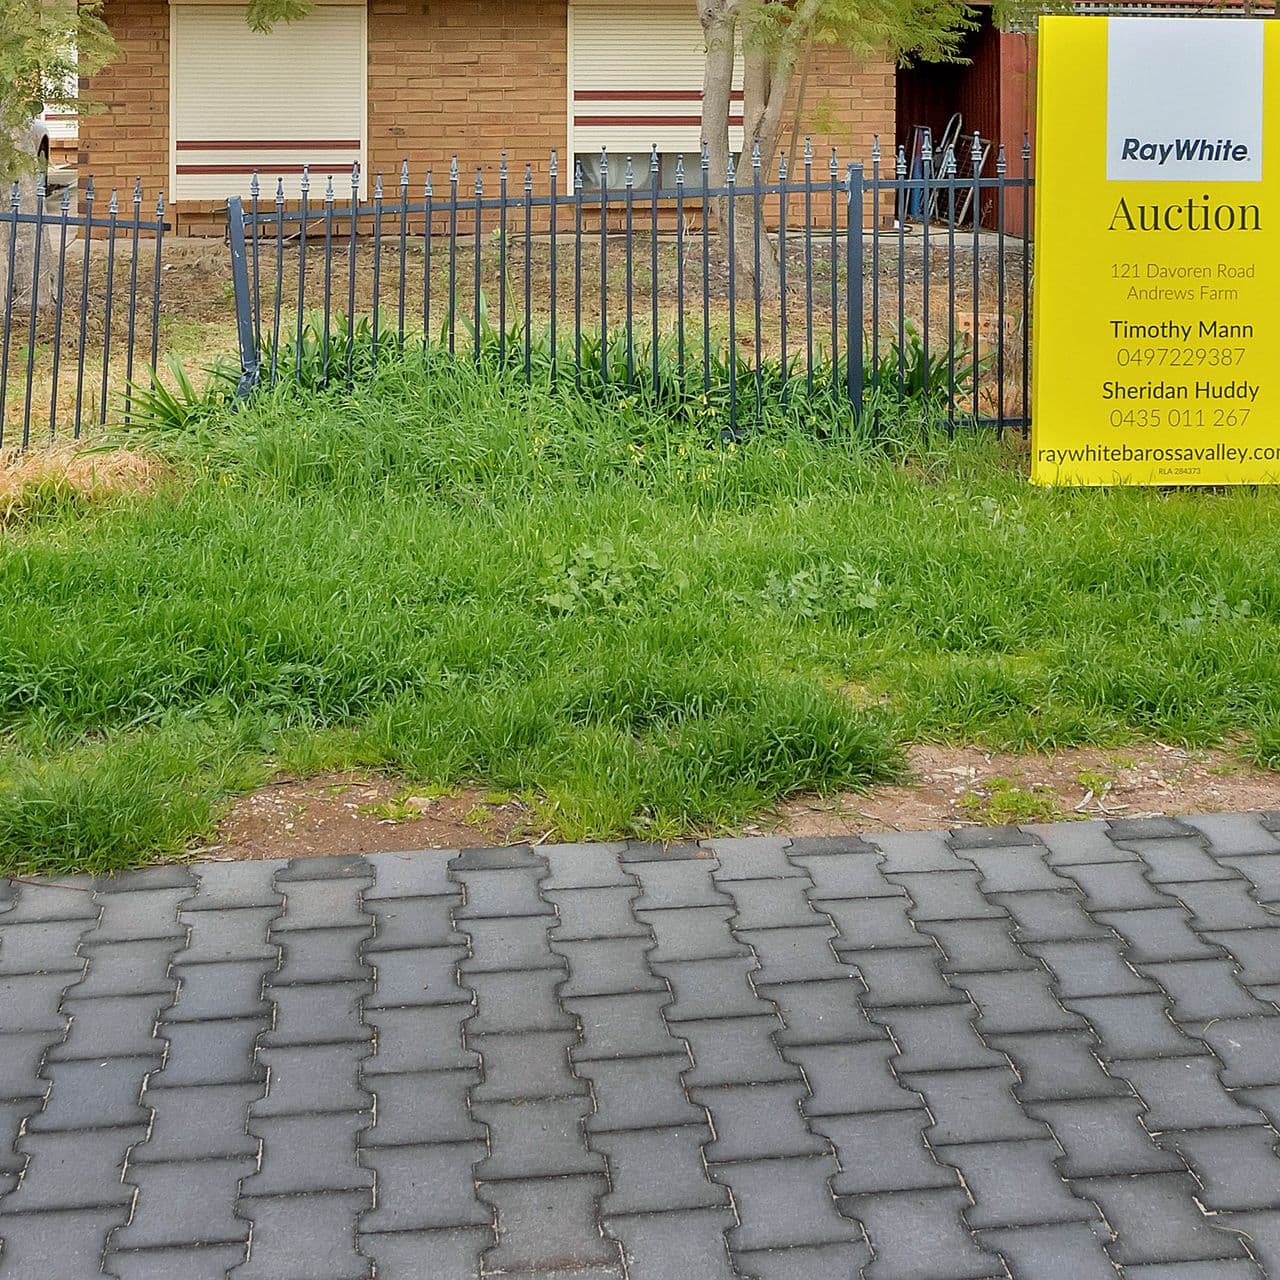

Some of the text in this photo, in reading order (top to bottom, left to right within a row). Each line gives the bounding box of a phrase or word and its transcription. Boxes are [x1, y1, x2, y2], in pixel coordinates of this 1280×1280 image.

[1107, 194, 1263, 231] Auction
[1111, 263, 1255, 278] 121 Davoren Road
[1127, 285, 1238, 300] Andrews Farm
[1110, 320, 1253, 341] Timothy Mann
[1117, 348, 1246, 366] 0497229387
[1102, 380, 1260, 402] Sheridan Huddy
[1110, 408, 1251, 427] 0435 011 267
